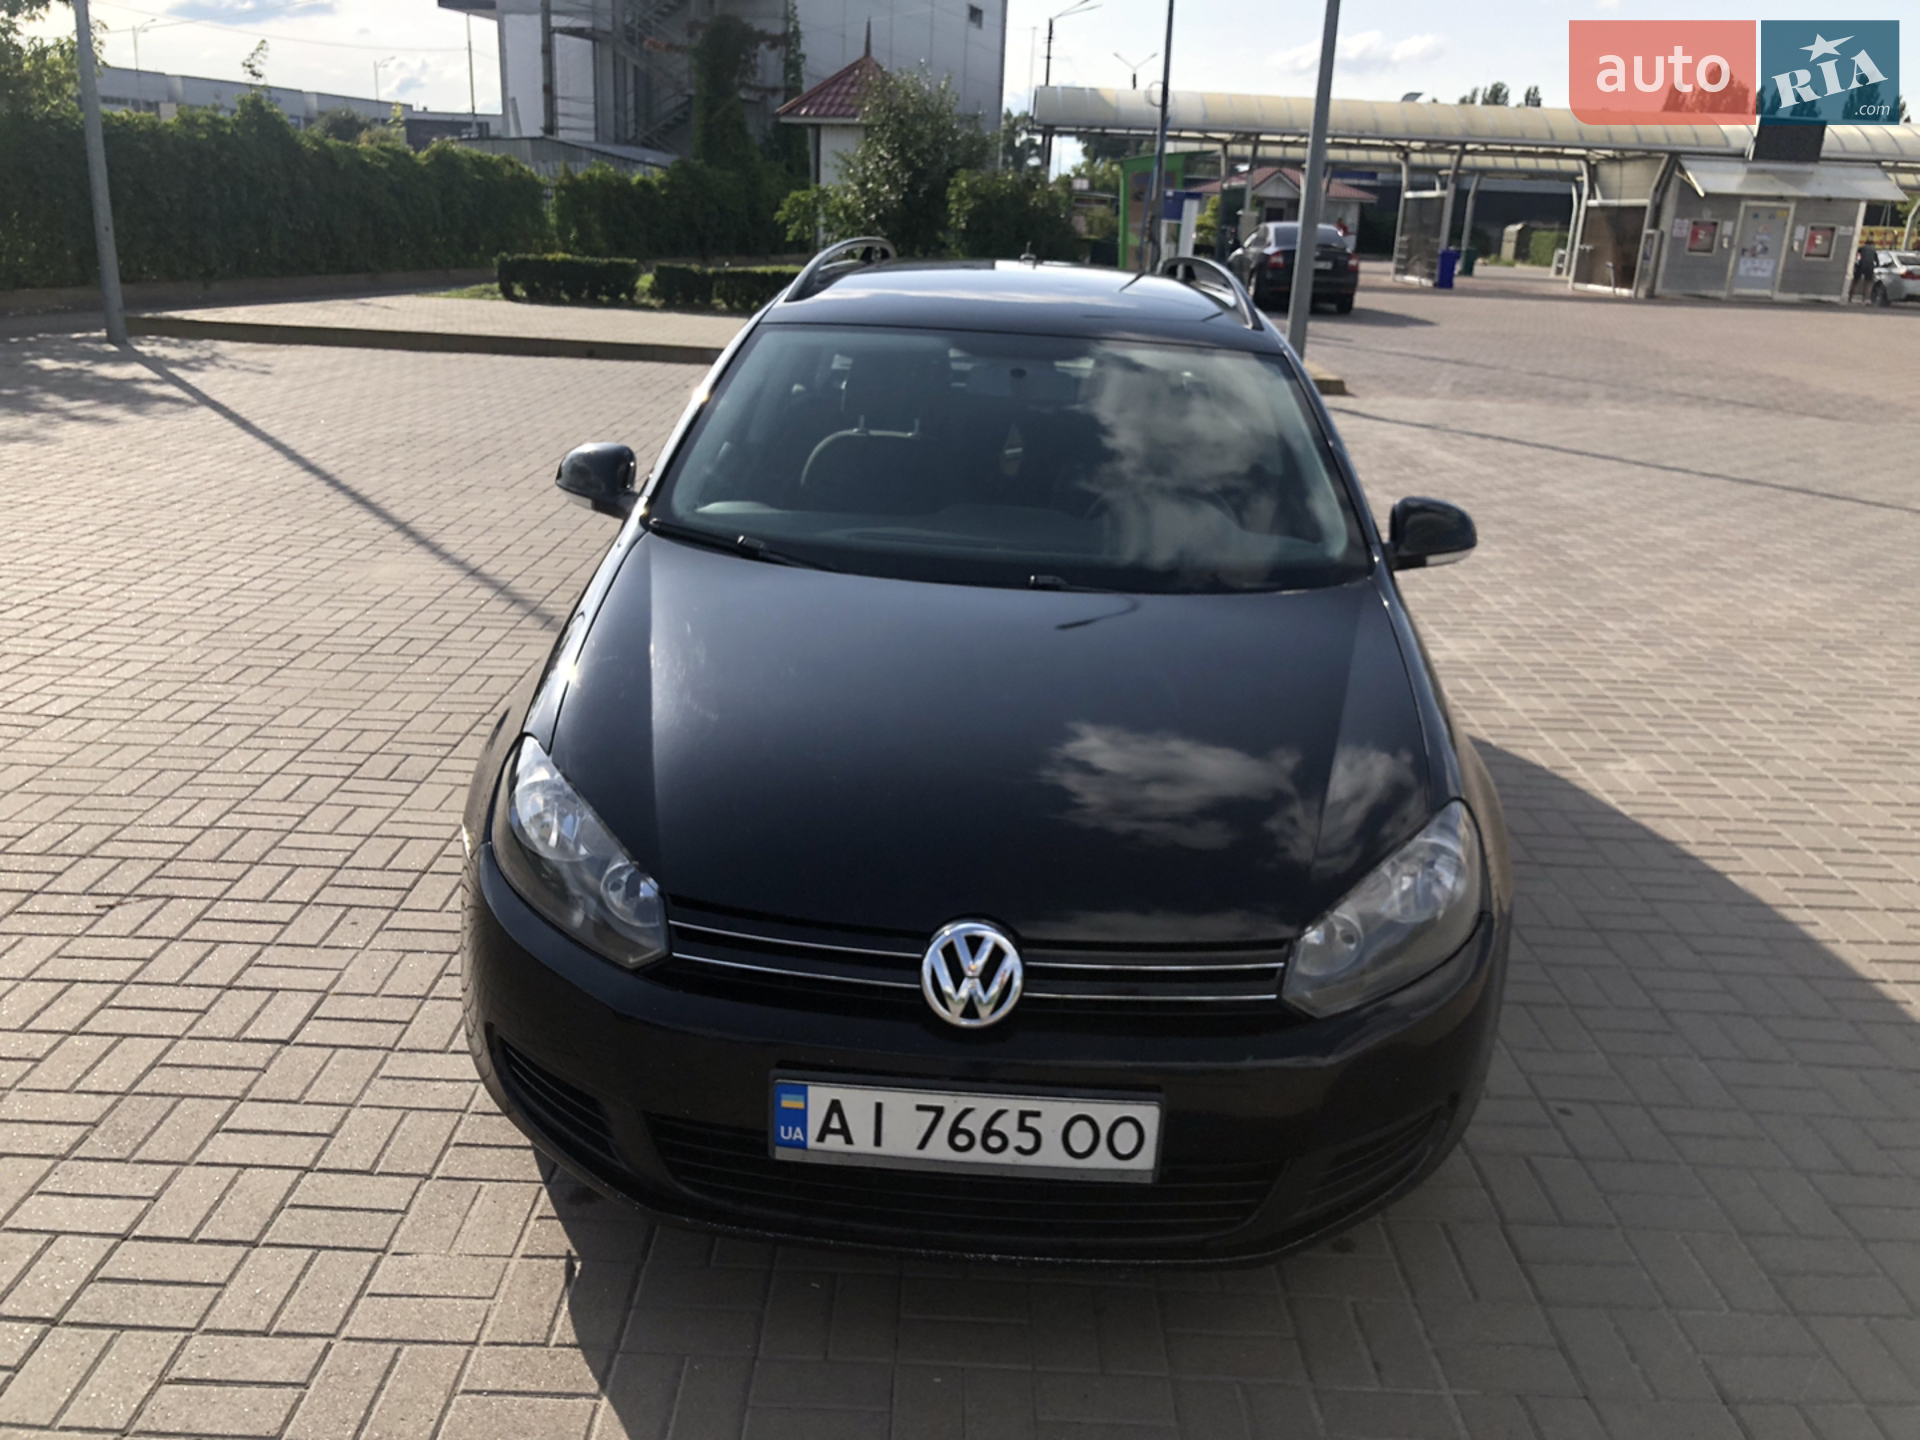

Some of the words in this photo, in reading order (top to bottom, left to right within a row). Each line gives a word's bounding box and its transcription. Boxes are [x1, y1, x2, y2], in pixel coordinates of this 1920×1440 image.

[922, 921, 1023, 1028] VW
[780, 1125, 805, 1142] UA
[815, 1098, 884, 1147] AI
[915, 1103, 1042, 1156] 7665
[1061, 1113, 1145, 1161] OO
